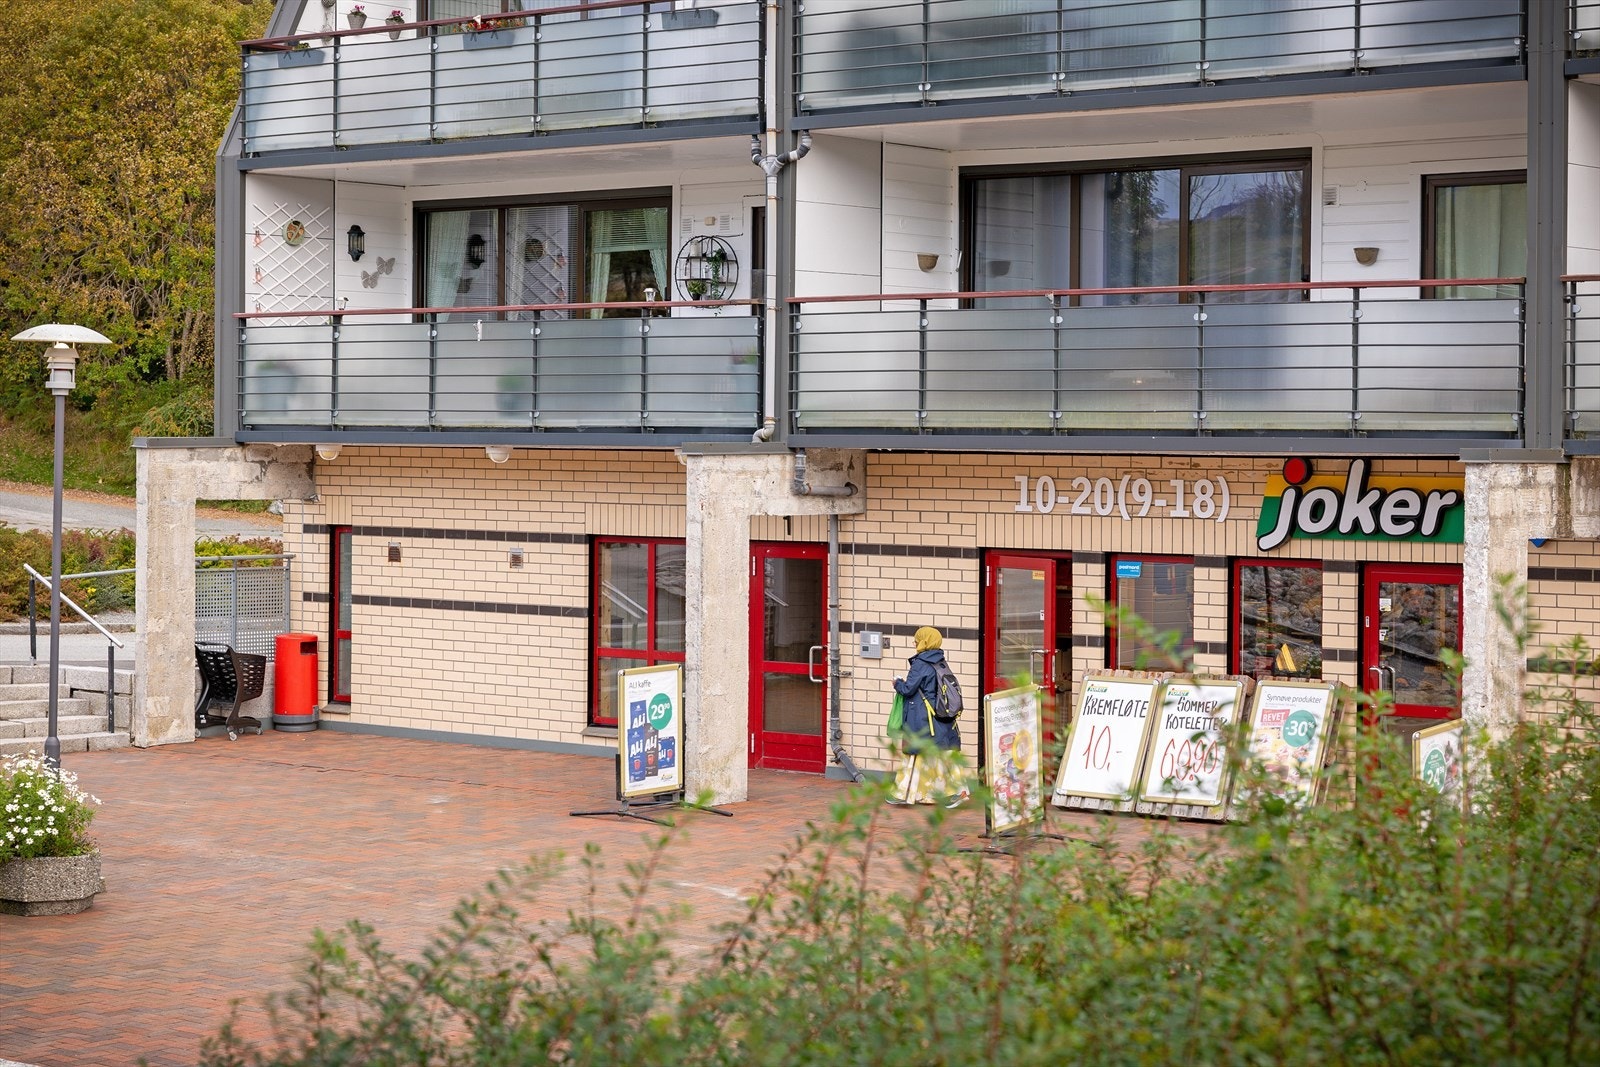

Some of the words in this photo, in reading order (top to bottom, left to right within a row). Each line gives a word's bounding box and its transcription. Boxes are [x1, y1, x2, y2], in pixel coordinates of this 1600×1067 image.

[1014, 474, 1230, 522] 10-20(9-18)
[1257, 458, 1459, 551] joker
[638, 679, 651, 689] kaffe
[1083, 695, 1149, 718] KREMFLØTE
[1266, 693, 1291, 702] Synnøve
[1291, 695, 1322, 704] produkter
[1262, 712, 1286, 722] REVET
